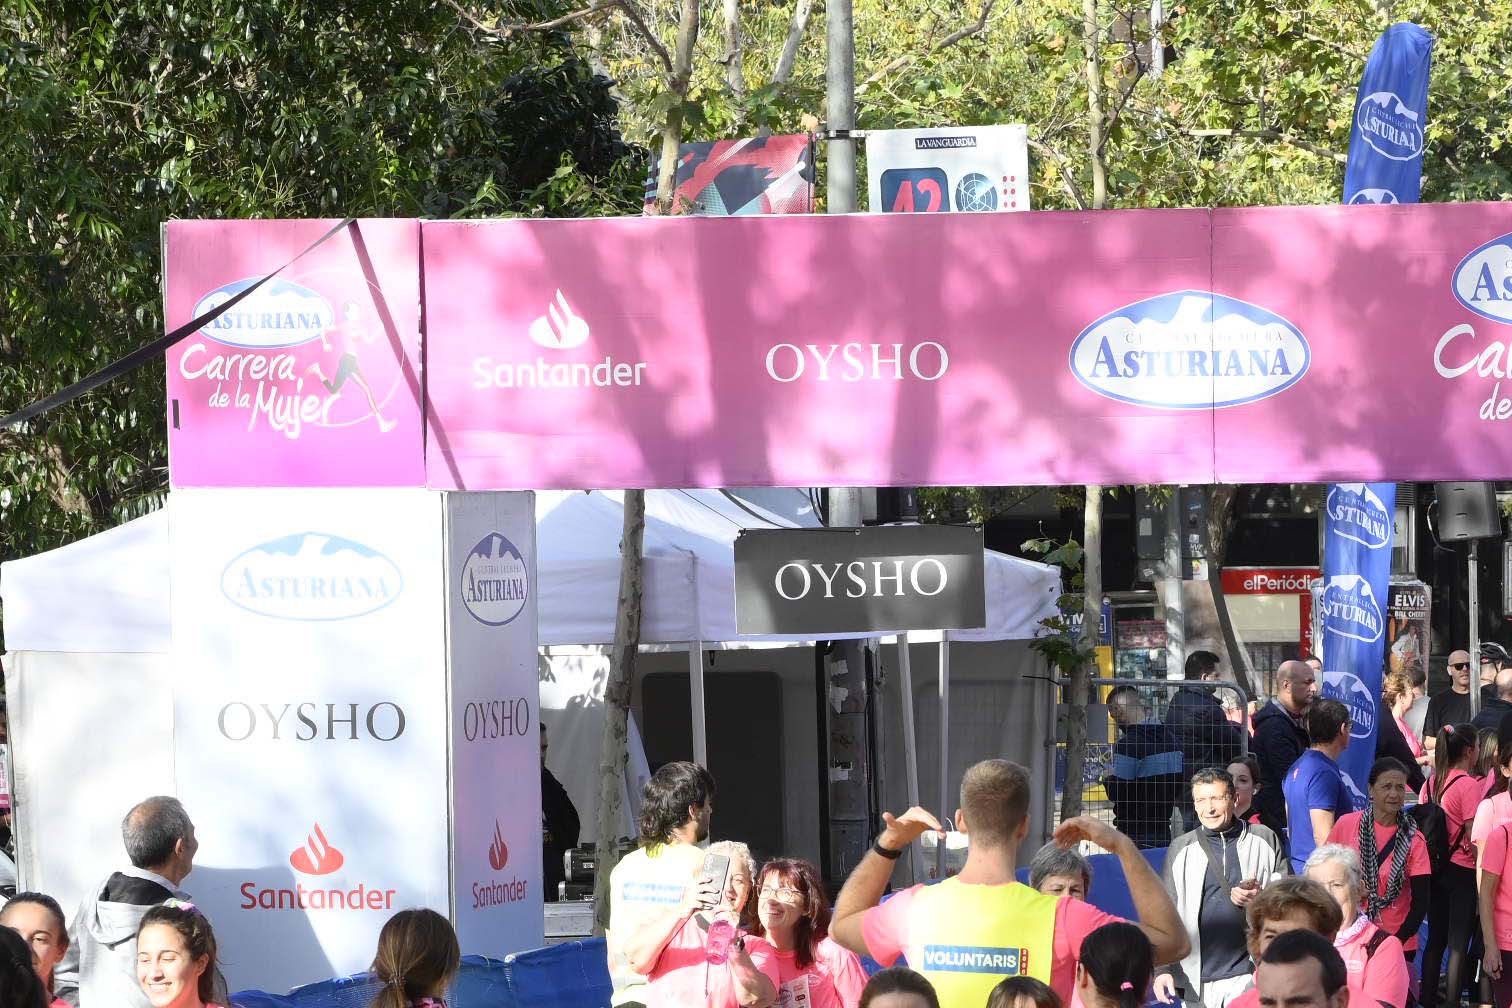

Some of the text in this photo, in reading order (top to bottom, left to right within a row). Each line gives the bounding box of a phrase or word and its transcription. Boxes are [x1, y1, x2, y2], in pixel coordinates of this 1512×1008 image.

[179, 343, 296, 380] Carrera
[473, 356, 646, 389] Santander
[765, 341, 950, 383] OYSHO
[1089, 335, 1292, 378] ASTURIANA
[208, 377, 343, 439] de la Mujer
[1479, 382, 1512, 420] de
[237, 567, 389, 599] ASTURIANA
[466, 568, 525, 603] ASTURIANA
[774, 558, 948, 600] OYSHO
[1395, 594, 1425, 607] ELVIS
[217, 701, 407, 741] OYSHO
[463, 697, 530, 742] OYSHO
[240, 882, 397, 910] Santander
[472, 875, 528, 910] Santander
[924, 951, 1018, 968] VOLUNTARIS
